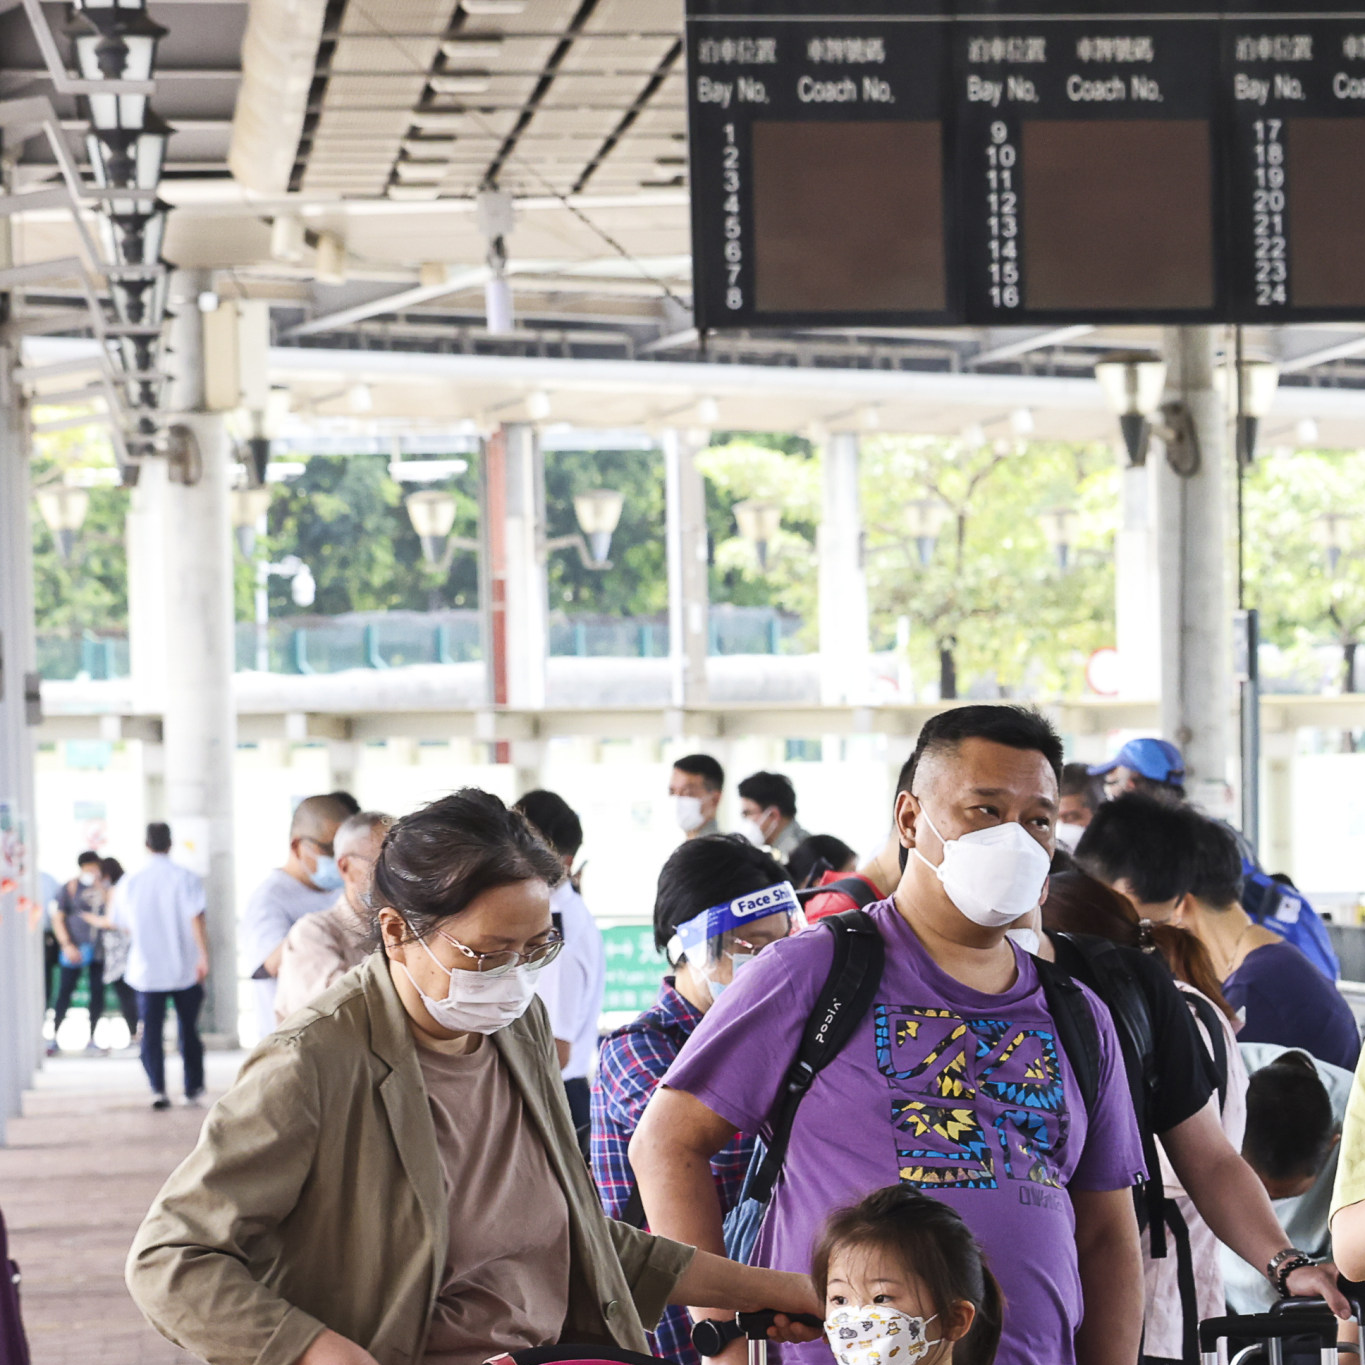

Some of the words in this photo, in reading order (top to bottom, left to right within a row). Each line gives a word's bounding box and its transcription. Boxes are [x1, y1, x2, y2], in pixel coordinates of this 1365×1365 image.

[697, 75, 733, 109] Bay
[737, 75, 770, 104] No.
[797, 75, 857, 103] Coach
[862, 75, 895, 104] No.
[967, 74, 1003, 107] Bay
[1007, 74, 1039, 103] No.
[1066, 74, 1126, 102] Coach
[1130, 74, 1163, 103] No.
[1234, 72, 1270, 106] Bay
[1274, 72, 1306, 101] No.
[722, 123, 736, 146] 1
[989, 121, 1009, 144] 9
[1252, 119, 1283, 142] 17
[722, 146, 741, 170] 2
[985, 144, 1018, 168] 10
[1253, 142, 1285, 166] 18
[722, 170, 741, 193] 3
[985, 168, 1013, 191] 11
[1253, 166, 1286, 189] 19
[722, 193, 741, 216] 4
[986, 191, 1018, 214] 12
[1252, 189, 1287, 212] 20
[723, 216, 743, 239] 5
[986, 214, 1019, 237] 13
[1252, 212, 1284, 235] 21
[723, 239, 743, 262] 6
[987, 237, 1019, 260] 14
[1253, 235, 1287, 258] 22
[725, 262, 743, 286] 7
[987, 260, 1020, 284] 15
[1254, 258, 1288, 282] 23
[724, 286, 744, 309] 8
[988, 284, 1021, 307] 16
[1255, 282, 1288, 305] 24
[737, 894, 771, 913] Face
[772, 888, 792, 902] Shi
